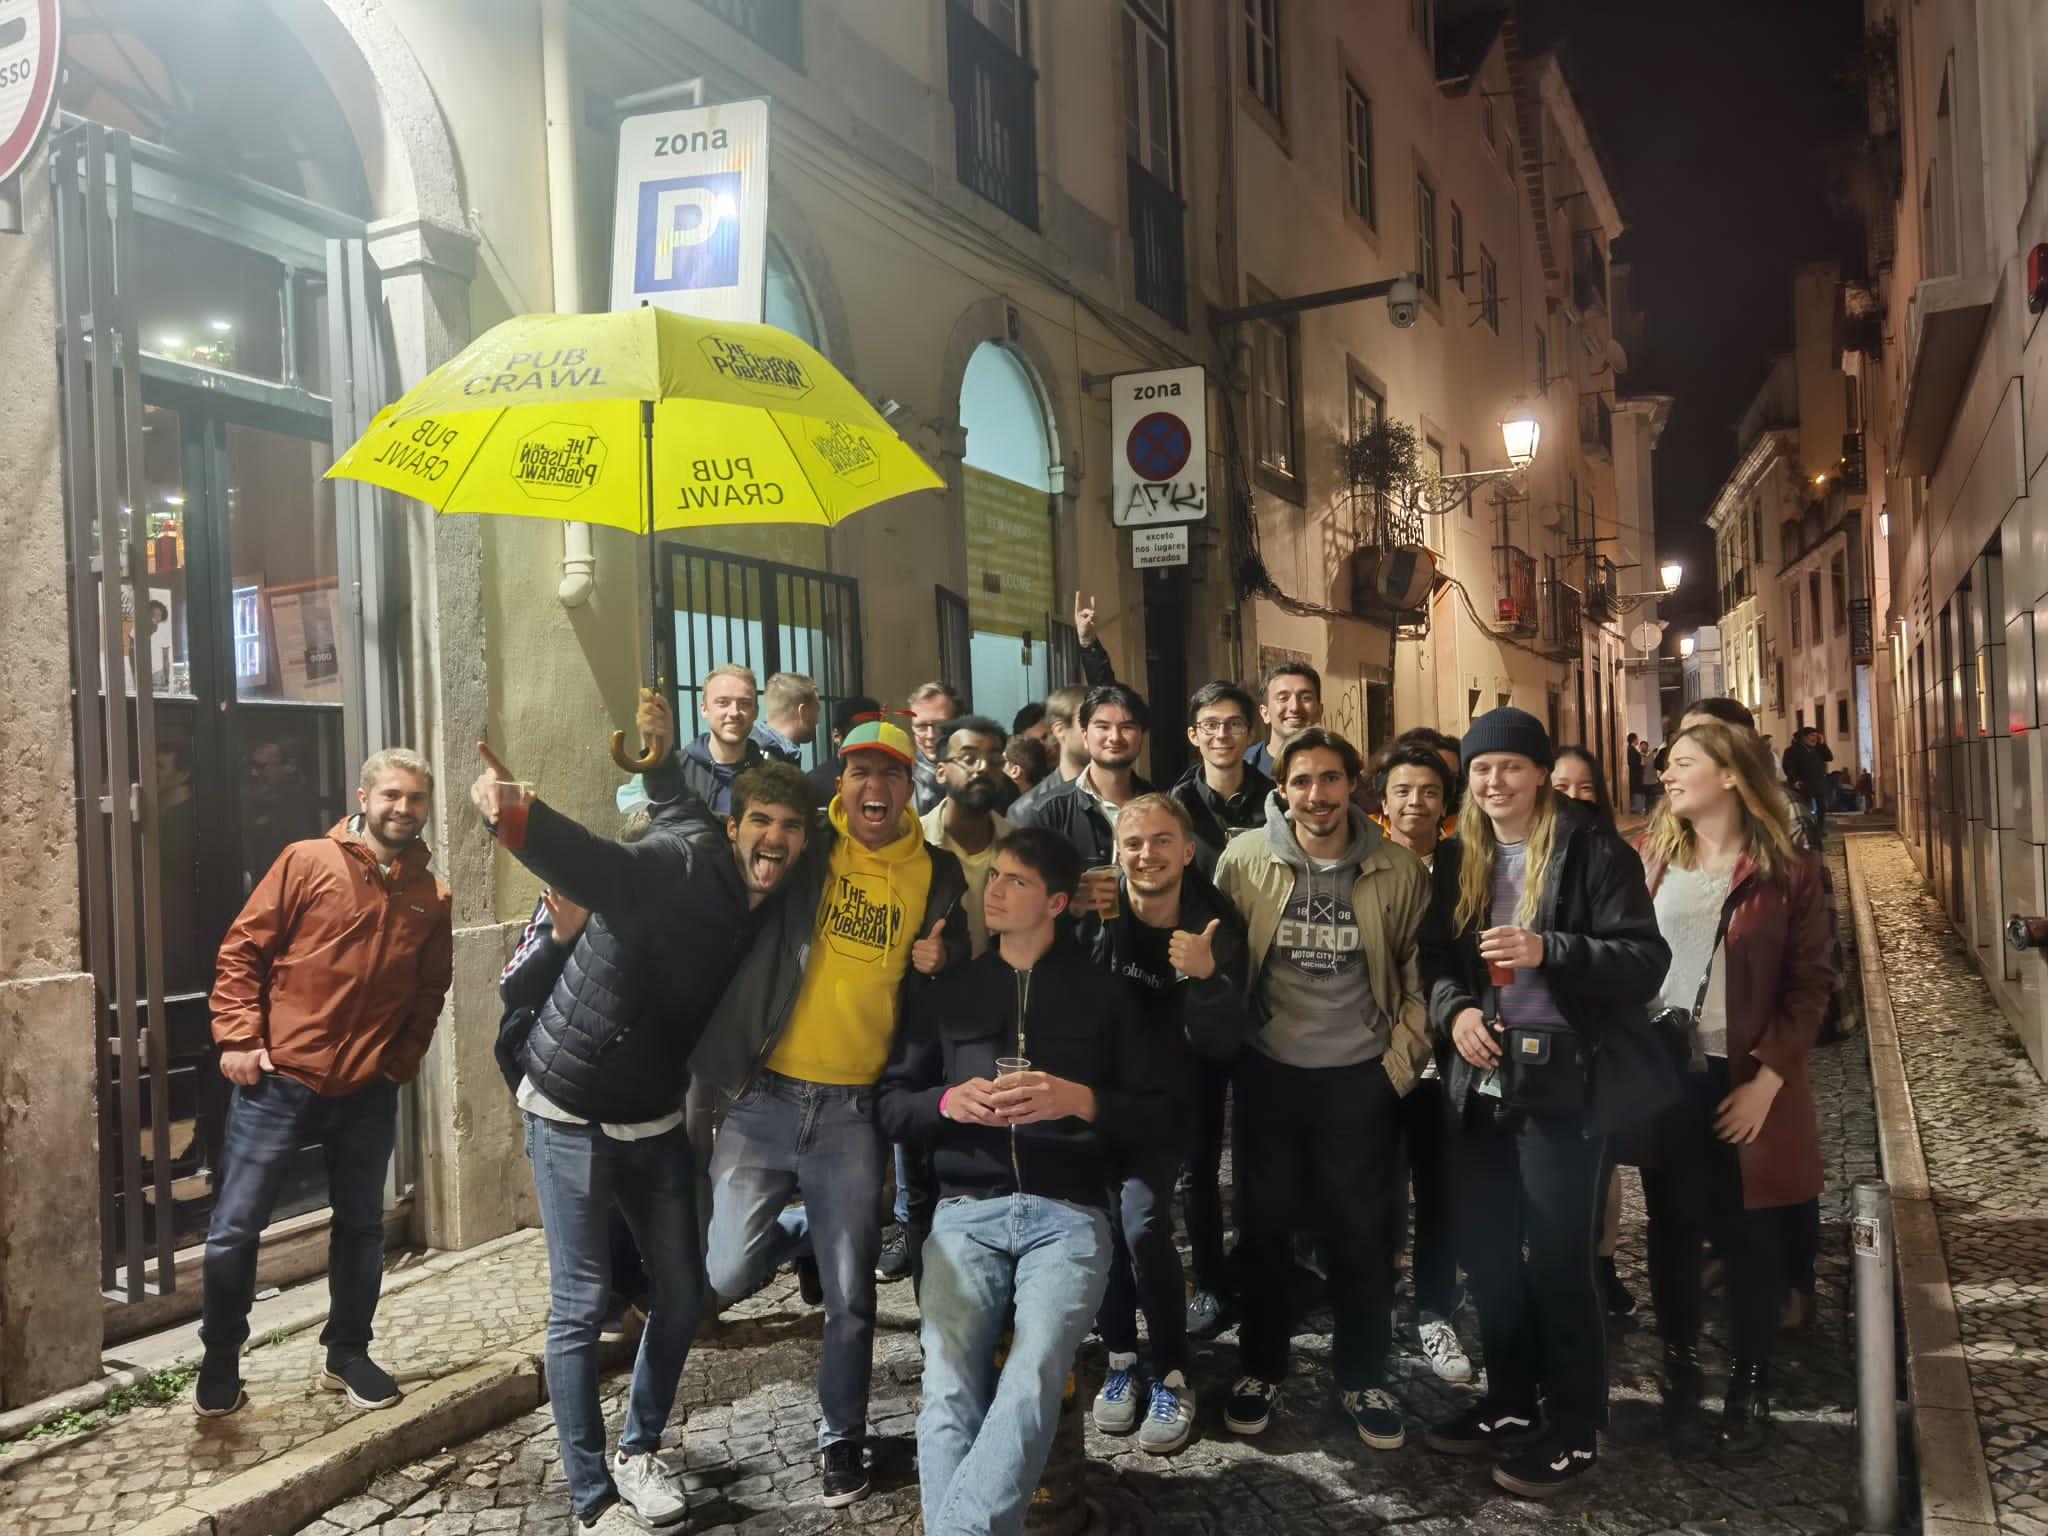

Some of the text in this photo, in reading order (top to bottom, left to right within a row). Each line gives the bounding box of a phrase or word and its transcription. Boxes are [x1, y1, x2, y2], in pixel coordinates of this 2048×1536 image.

[654, 128, 729, 158] zona
[654, 187, 719, 281] P
[505, 347, 588, 371] PUB
[464, 366, 608, 396] CRAWL
[1133, 382, 1182, 401] zona
[1135, 541, 1187, 553] nos lugares
[1145, 532, 1175, 541] exceto
[1140, 554, 1182, 564] marcados
[839, 876, 867, 904] THE
[1291, 950, 1315, 960] MOTOR
[1316, 952, 1332, 960] CITY
